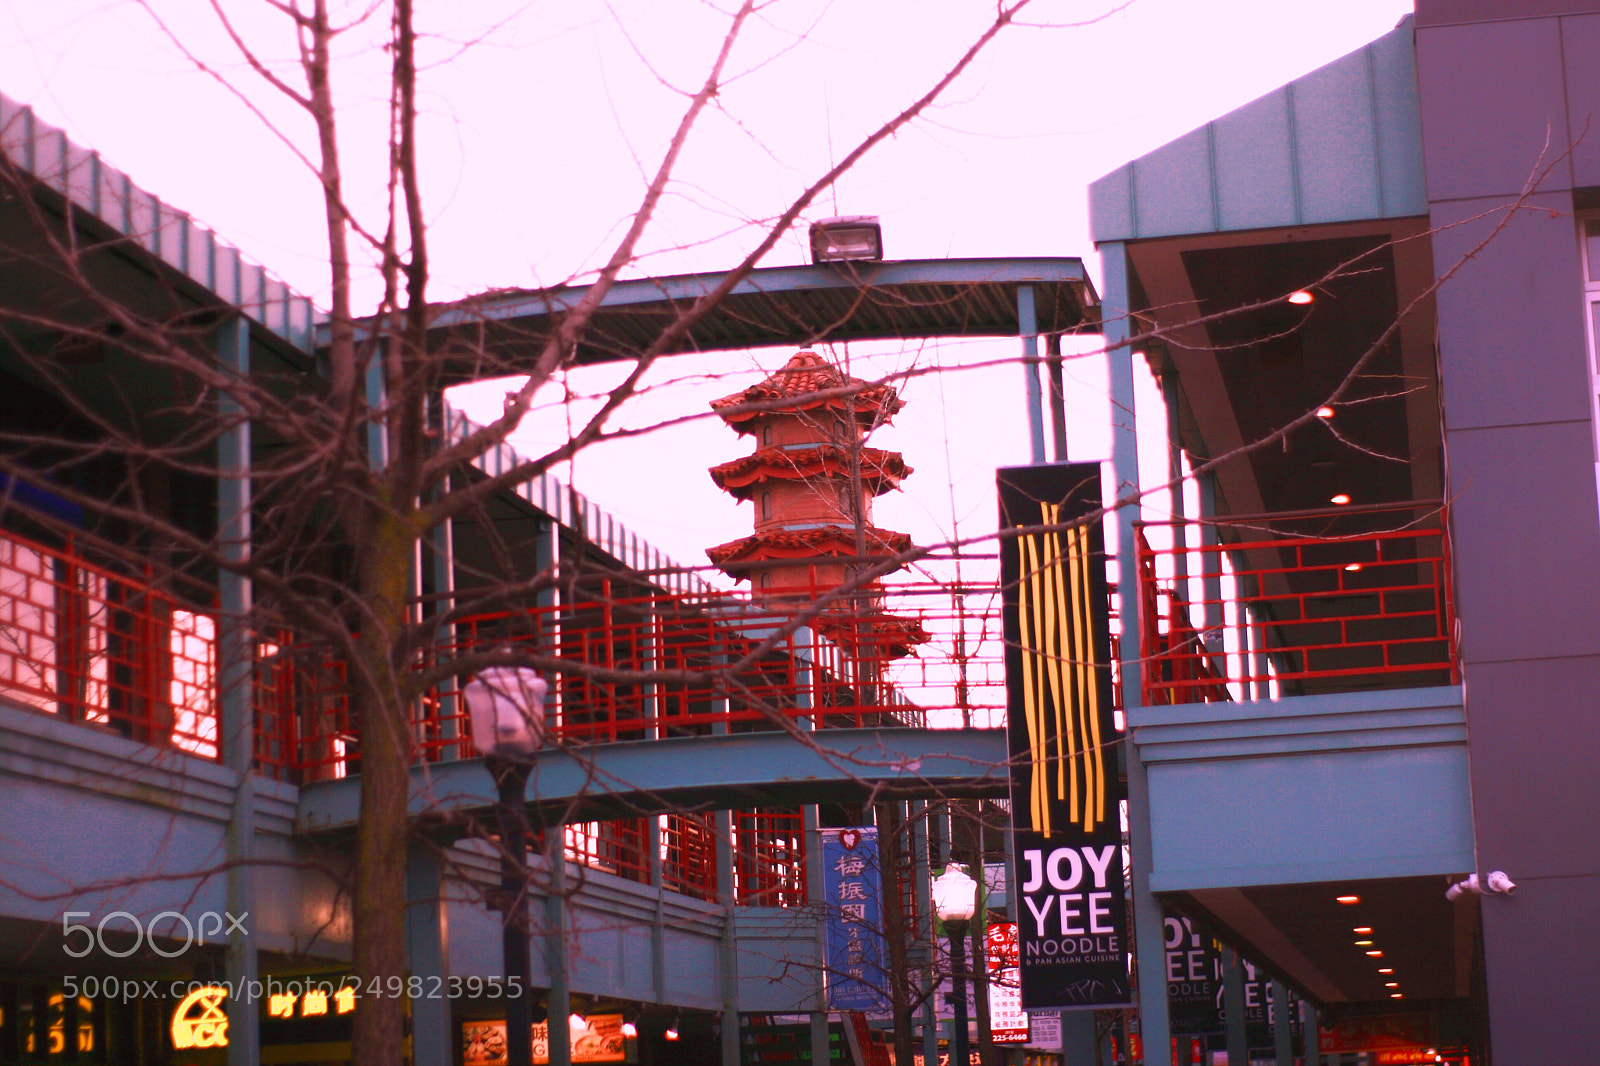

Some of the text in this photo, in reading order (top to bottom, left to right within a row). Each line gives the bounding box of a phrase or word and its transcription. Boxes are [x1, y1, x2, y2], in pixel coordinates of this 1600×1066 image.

[1023, 845, 1116, 893] JOY
[1024, 892, 1114, 937] YEE
[1026, 936, 1120, 957] NOODLE
[1035, 957, 1052, 966] PAN
[1055, 955, 1081, 965] ASIAN
[1084, 953, 1120, 963] CUISINE
